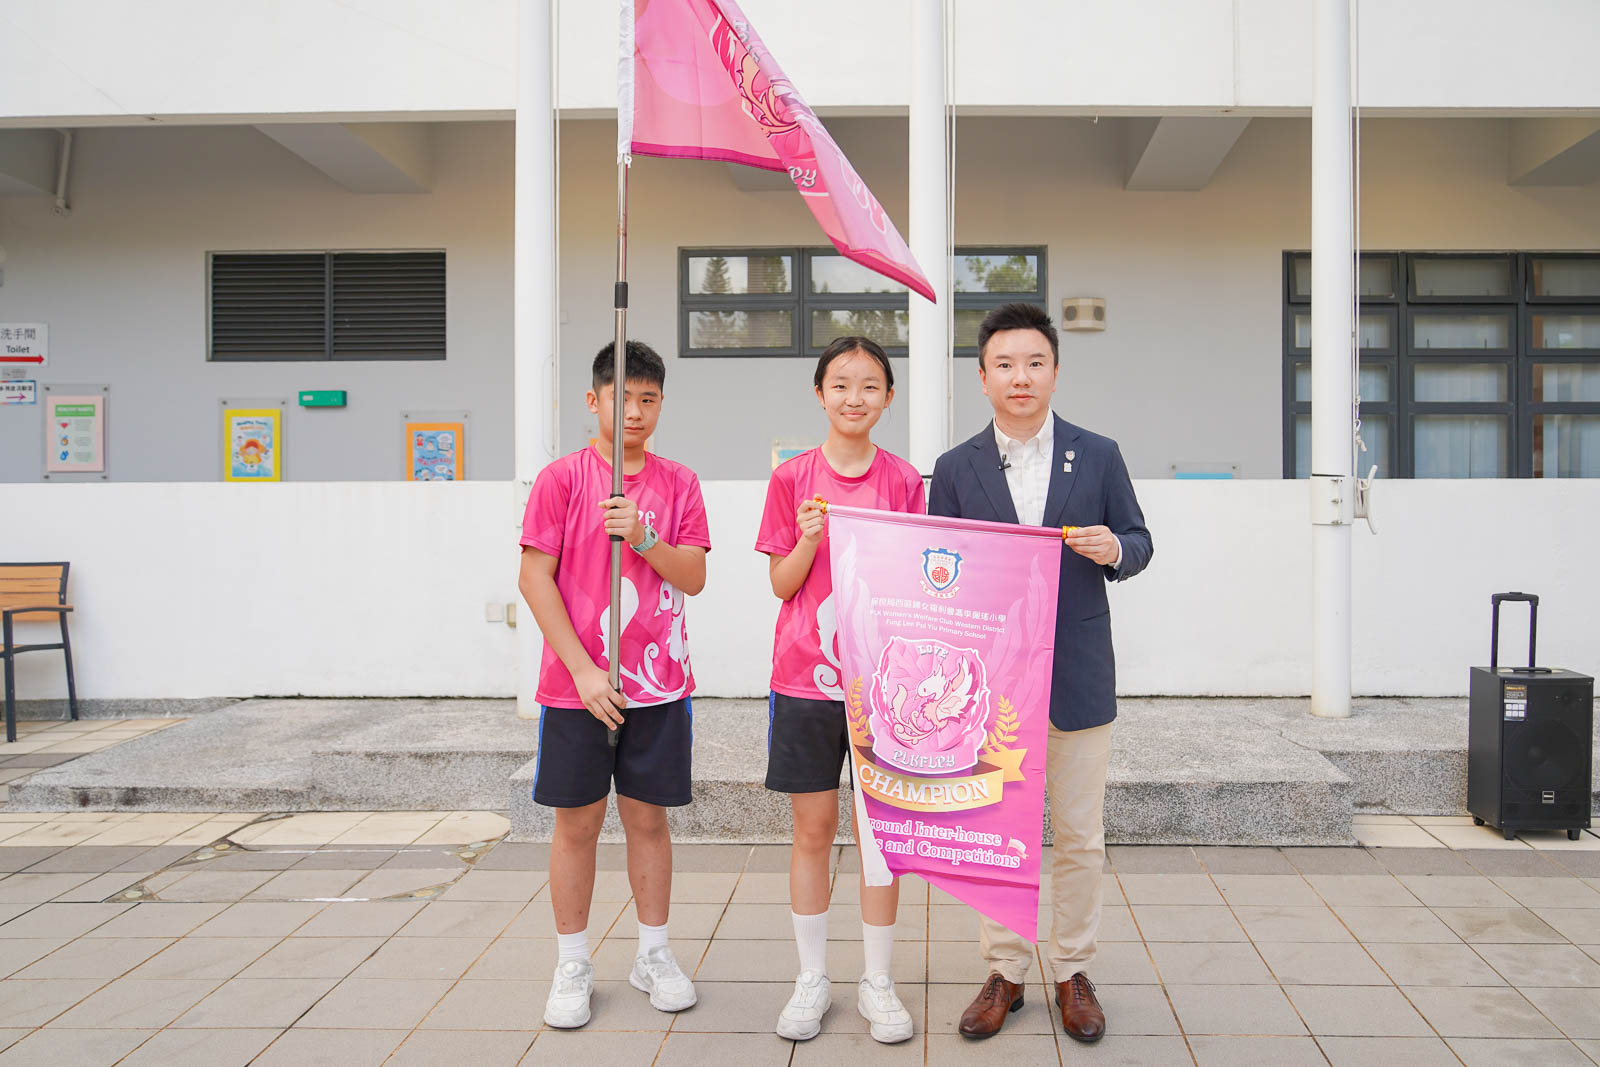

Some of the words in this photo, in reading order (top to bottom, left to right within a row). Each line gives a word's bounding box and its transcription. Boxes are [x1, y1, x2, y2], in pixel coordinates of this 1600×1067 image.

[0, 328, 36, 340] 洗手間
[6, 345, 30, 353] Toilet
[913, 613, 938, 622] Welfare
[939, 617, 954, 626] Club
[955, 620, 981, 631] Western
[982, 624, 1006, 634] District
[939, 625, 963, 637] Primary
[964, 630, 986, 640] School
[917, 645, 950, 660] LOVE
[859, 764, 990, 806] CHAMPION
[869, 818, 912, 835] round
[914, 821, 1002, 846] Inter-house
[885, 839, 914, 855] and
[917, 841, 1021, 868] Competitions
